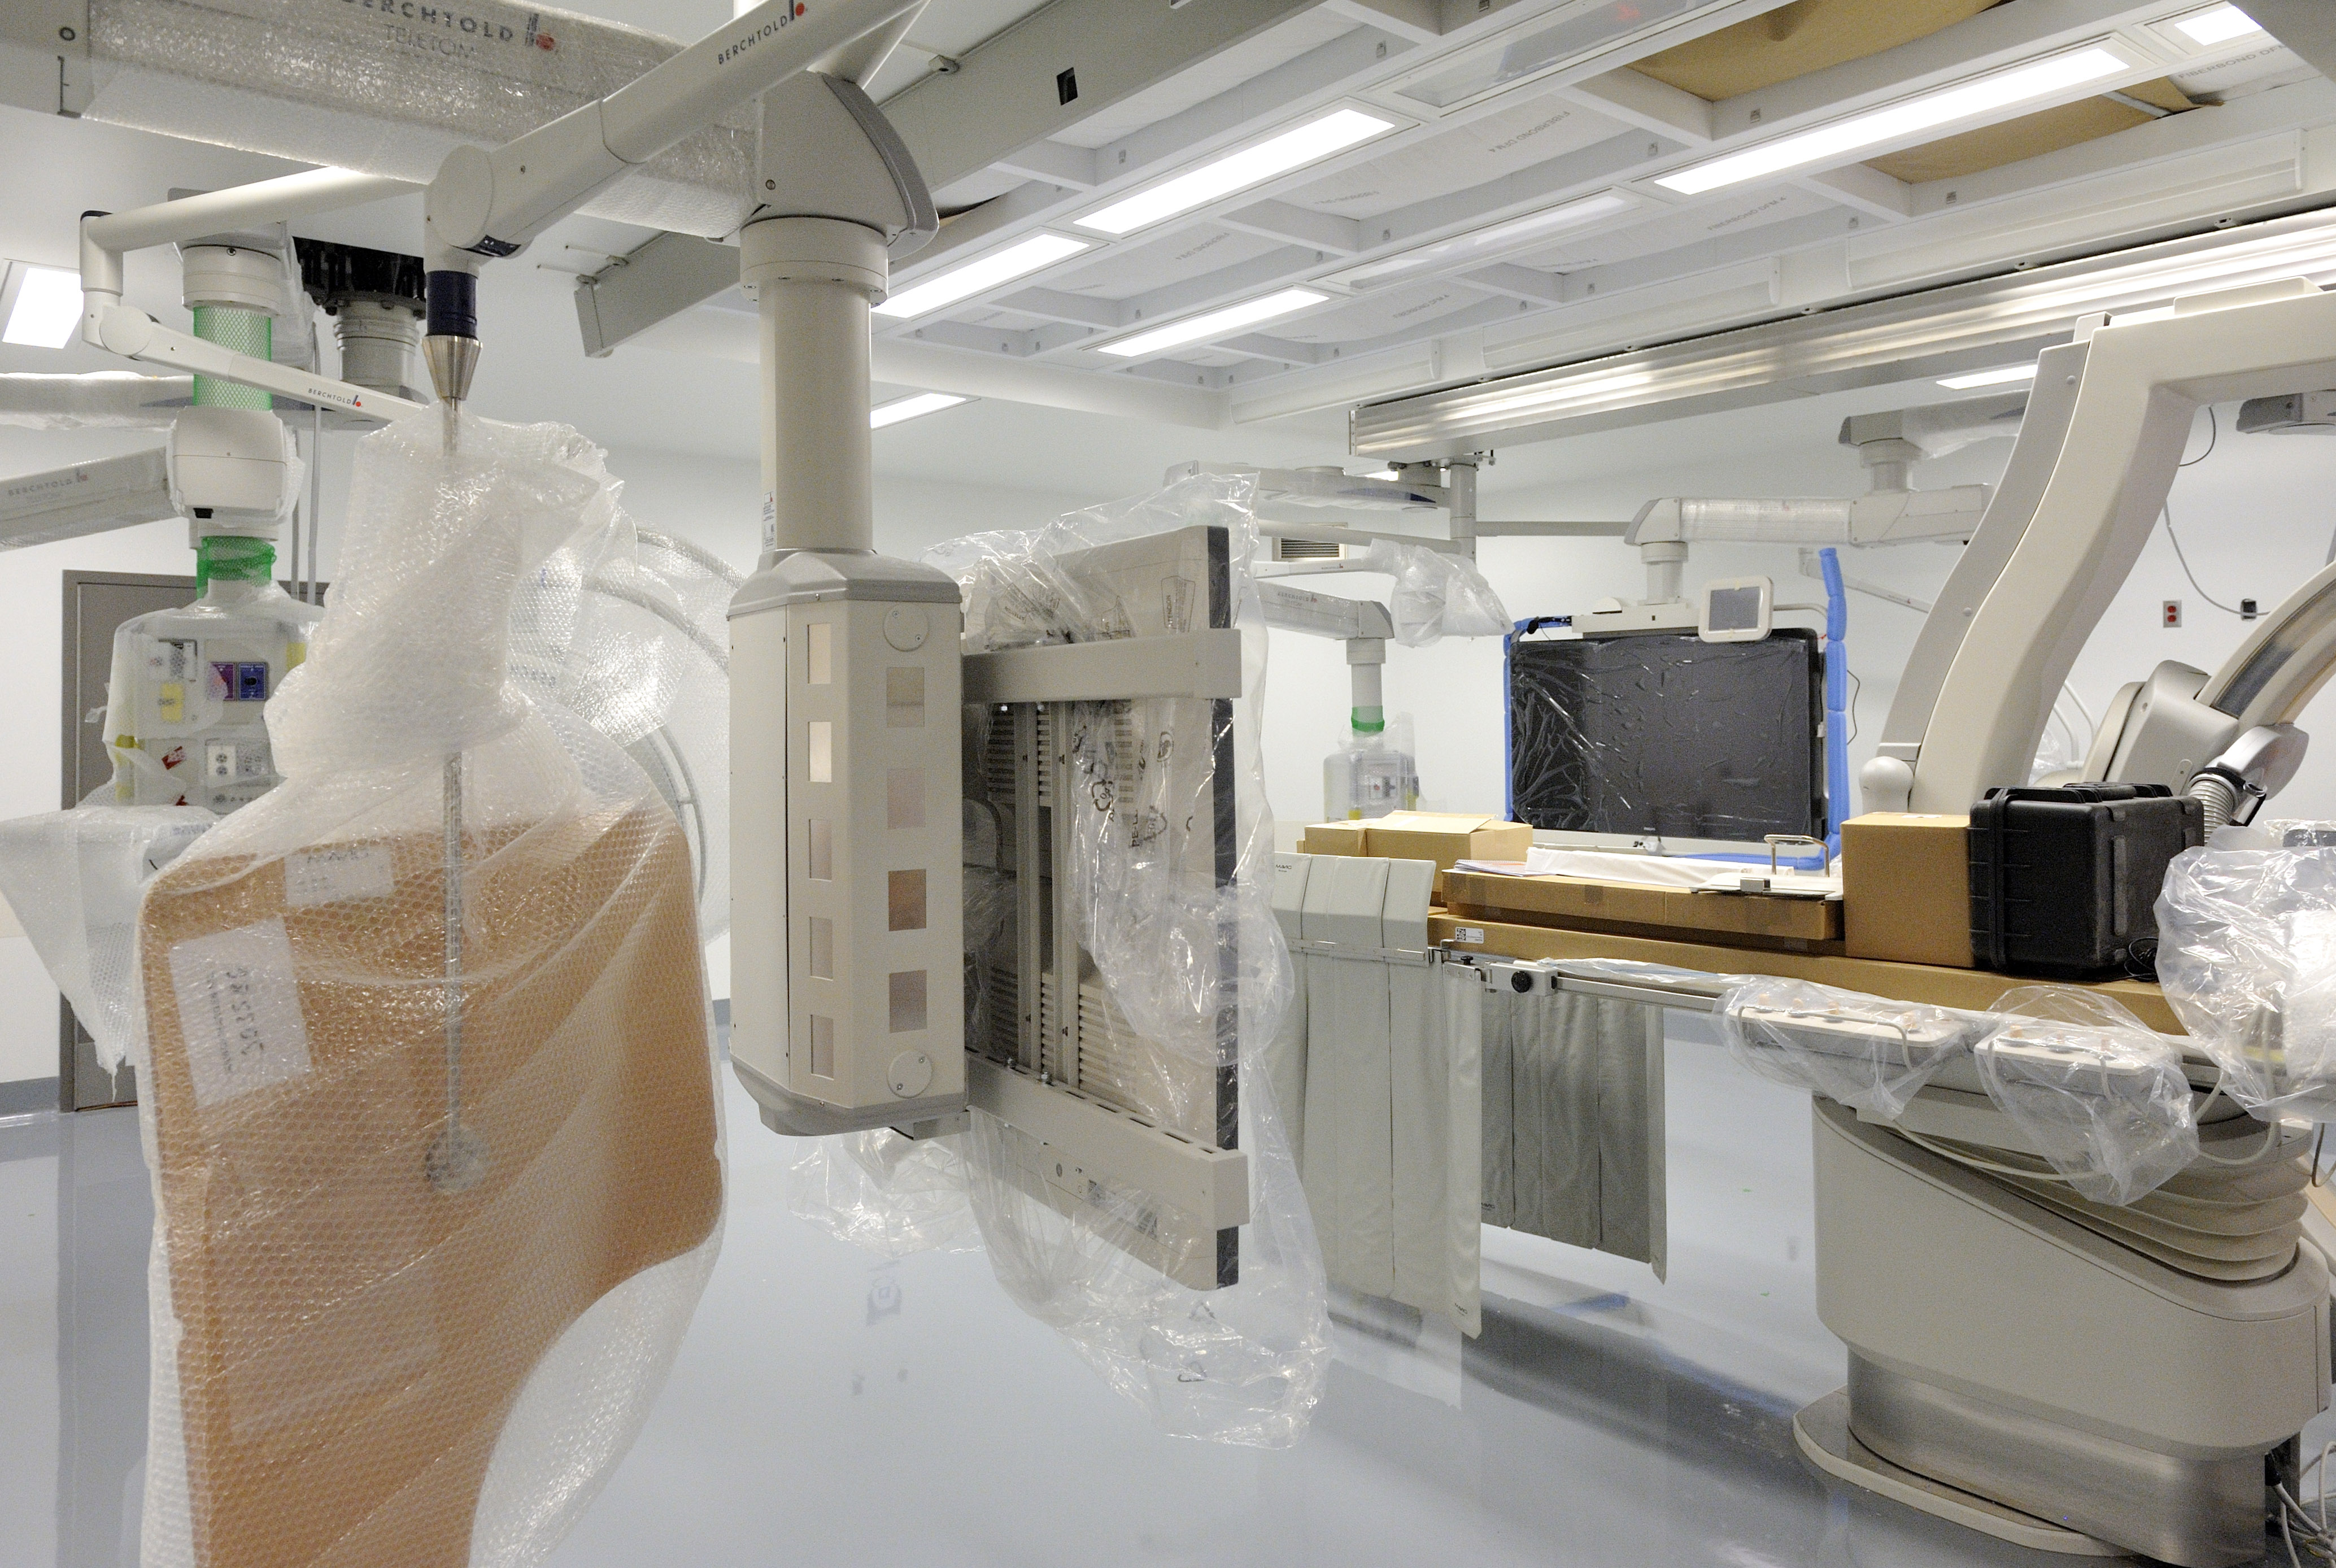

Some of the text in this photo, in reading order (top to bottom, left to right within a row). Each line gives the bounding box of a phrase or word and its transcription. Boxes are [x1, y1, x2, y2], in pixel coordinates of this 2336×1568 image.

[341, 0, 514, 42] ERCHTOLD
[717, 15, 787, 65] BERCHTOLD
[2178, 54, 2256, 78] FIBERBOND
[1516, 111, 1570, 141] FIBERBOND
[1707, 209, 1758, 230] FIBERBOND
[308, 388, 351, 404] BERCHTOLD
